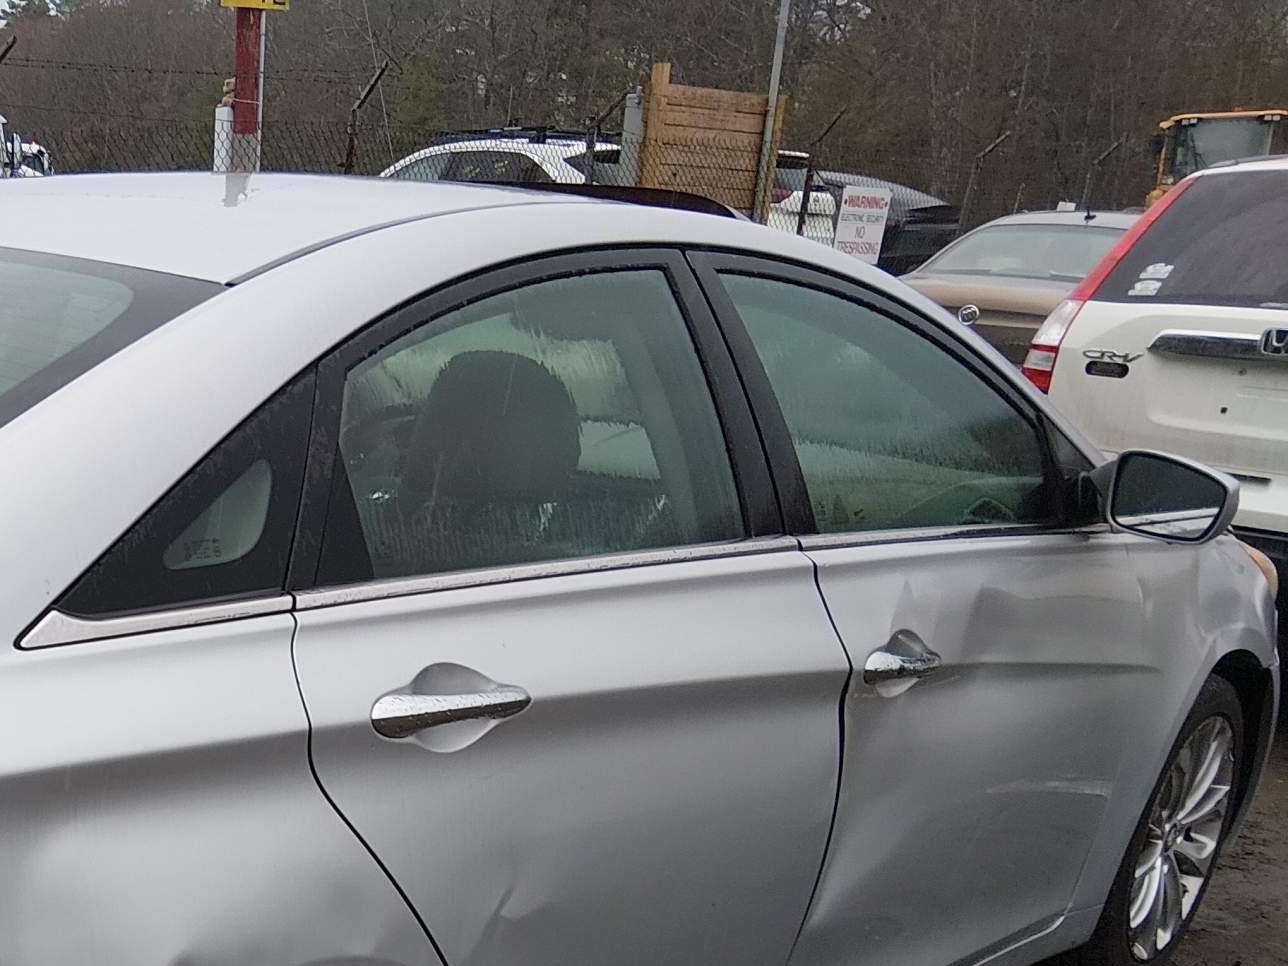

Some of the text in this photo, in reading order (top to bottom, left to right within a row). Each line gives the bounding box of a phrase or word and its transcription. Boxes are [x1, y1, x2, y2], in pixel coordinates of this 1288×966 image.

[848, 196, 885, 209] WARNING
[855, 226, 866, 238] NO
[837, 240, 879, 255] TRESPASSING
